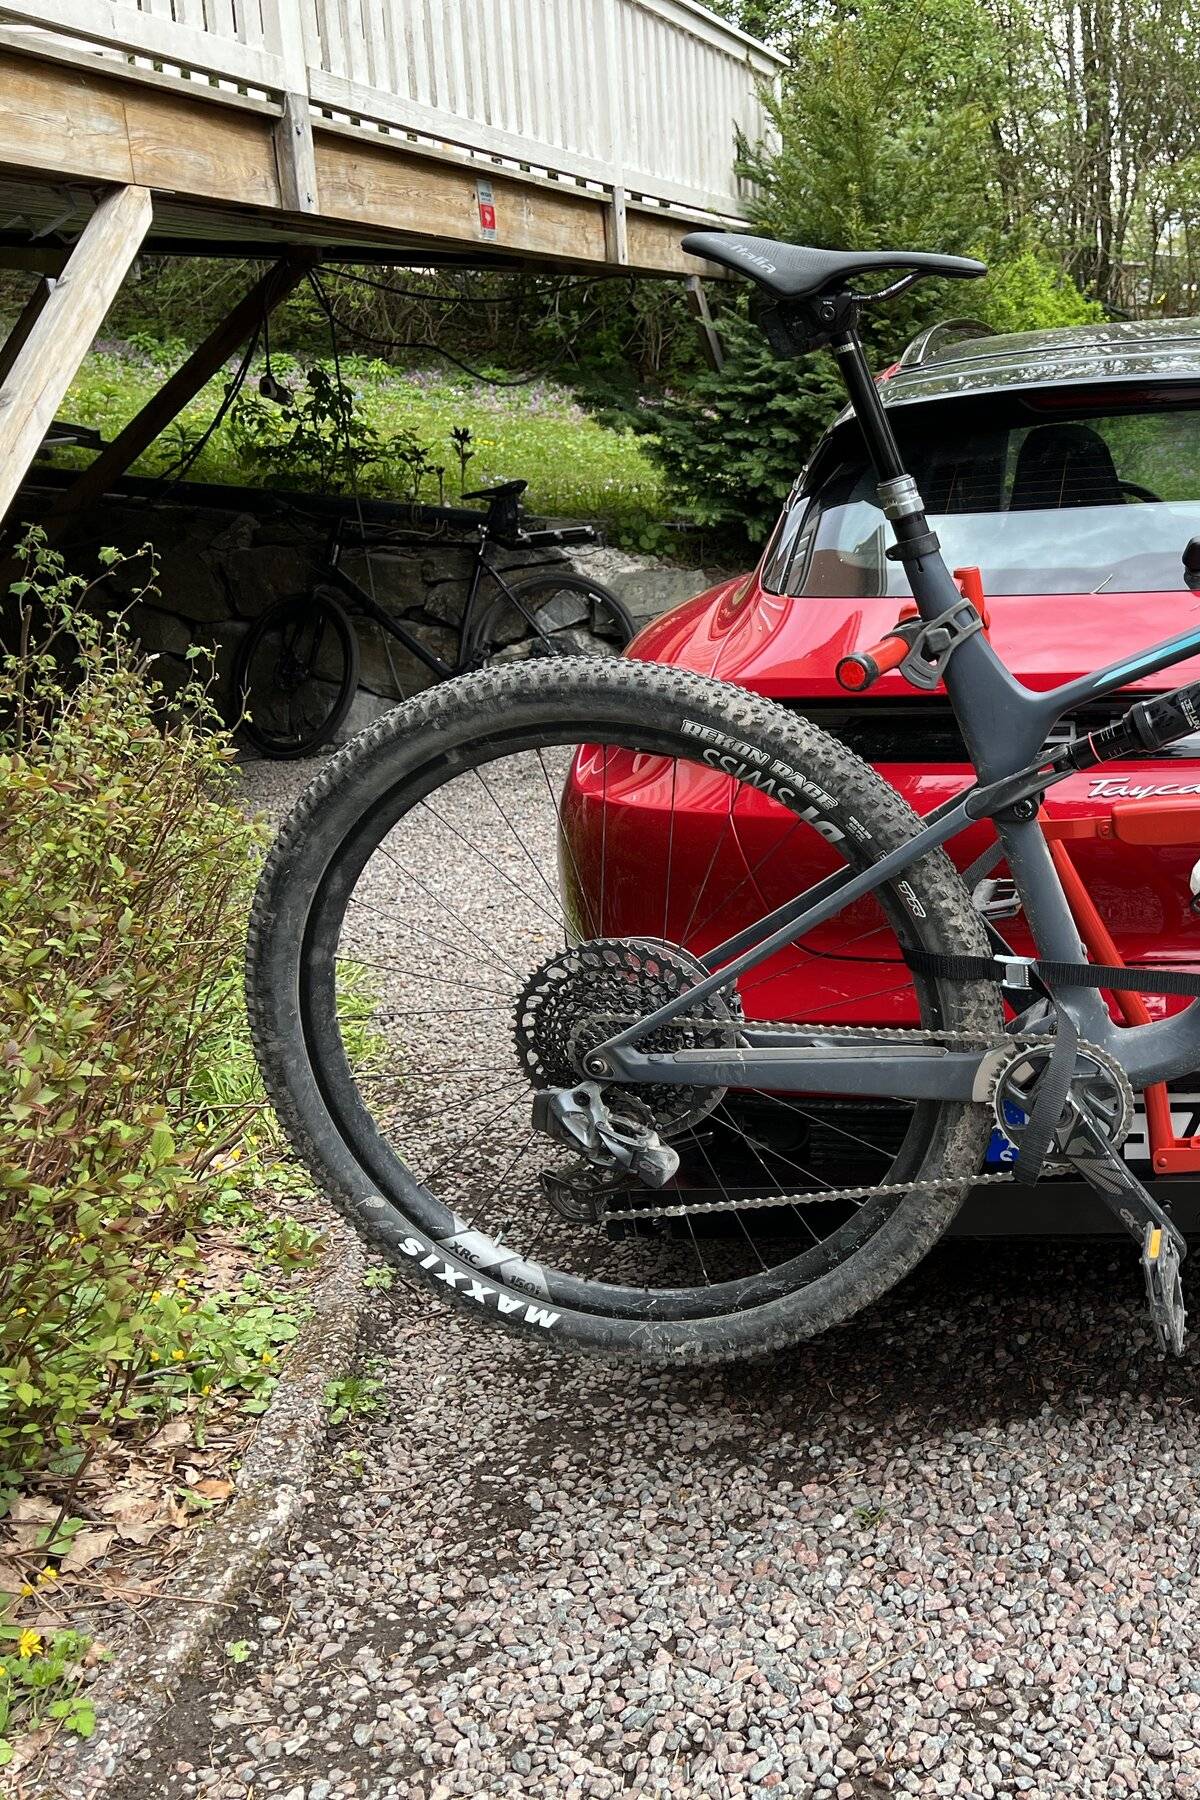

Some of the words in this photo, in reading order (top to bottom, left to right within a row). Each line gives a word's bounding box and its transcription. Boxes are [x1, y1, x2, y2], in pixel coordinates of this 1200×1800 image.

[680, 719, 770, 766] REKON
[769, 759, 839, 810] RACE
[702, 748, 796, 805] SWISS
[398, 1237, 562, 1329] MAXXIS
[449, 1240, 481, 1265] XRC
